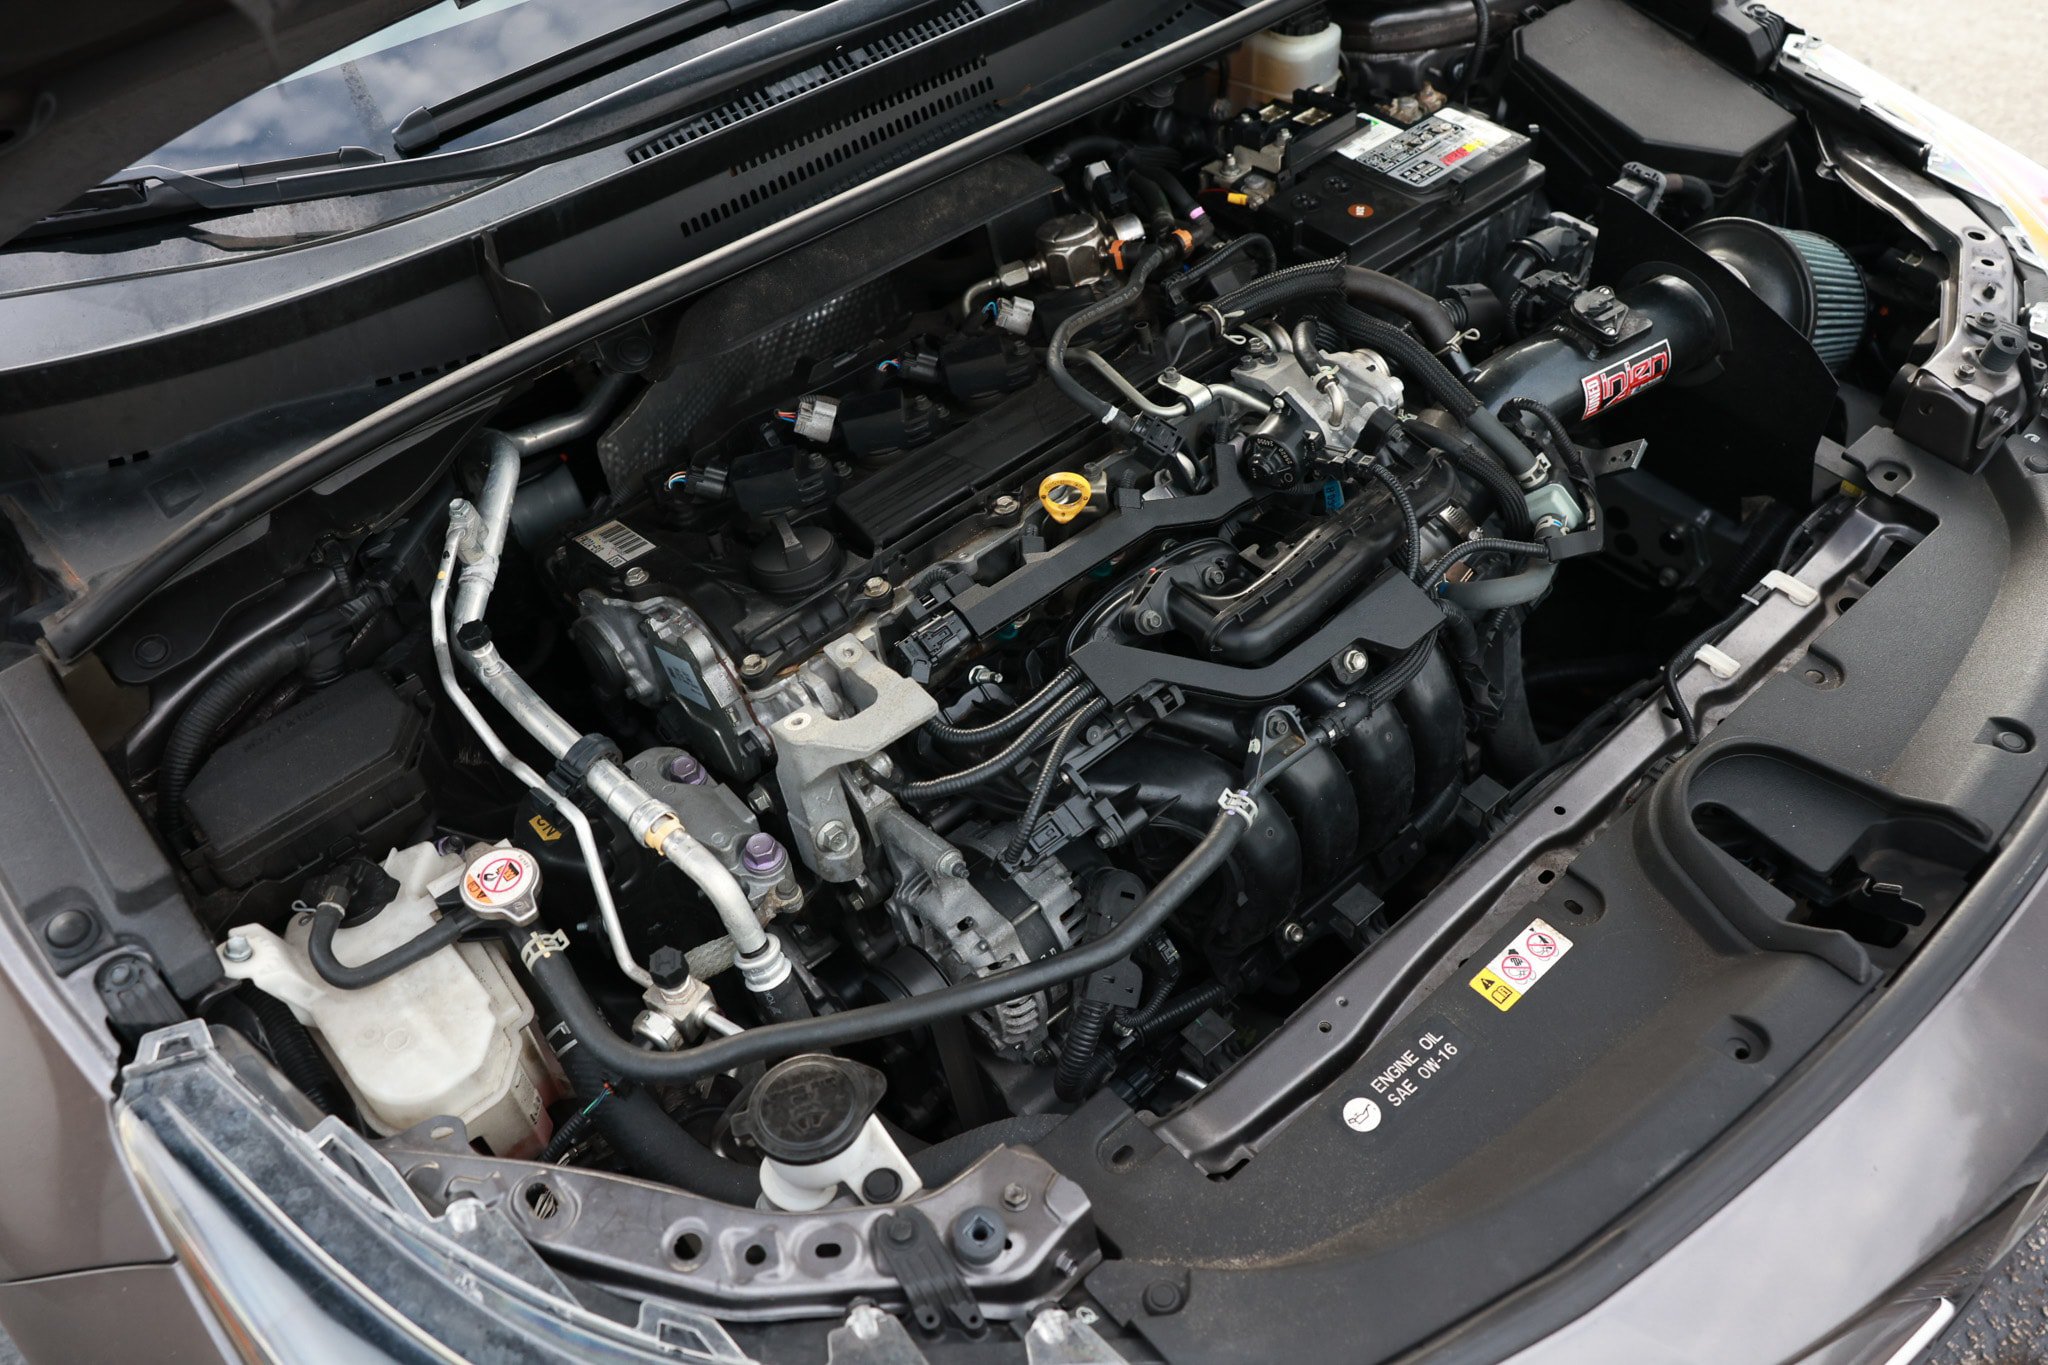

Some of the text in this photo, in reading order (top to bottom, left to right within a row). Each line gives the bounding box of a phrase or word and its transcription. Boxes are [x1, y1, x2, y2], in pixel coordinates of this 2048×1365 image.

[1586, 379, 1601, 416] TUNED
[1370, 1031, 1444, 1094] ENGINE OIL
[1387, 1042, 1458, 1107] SAE 0W-16
